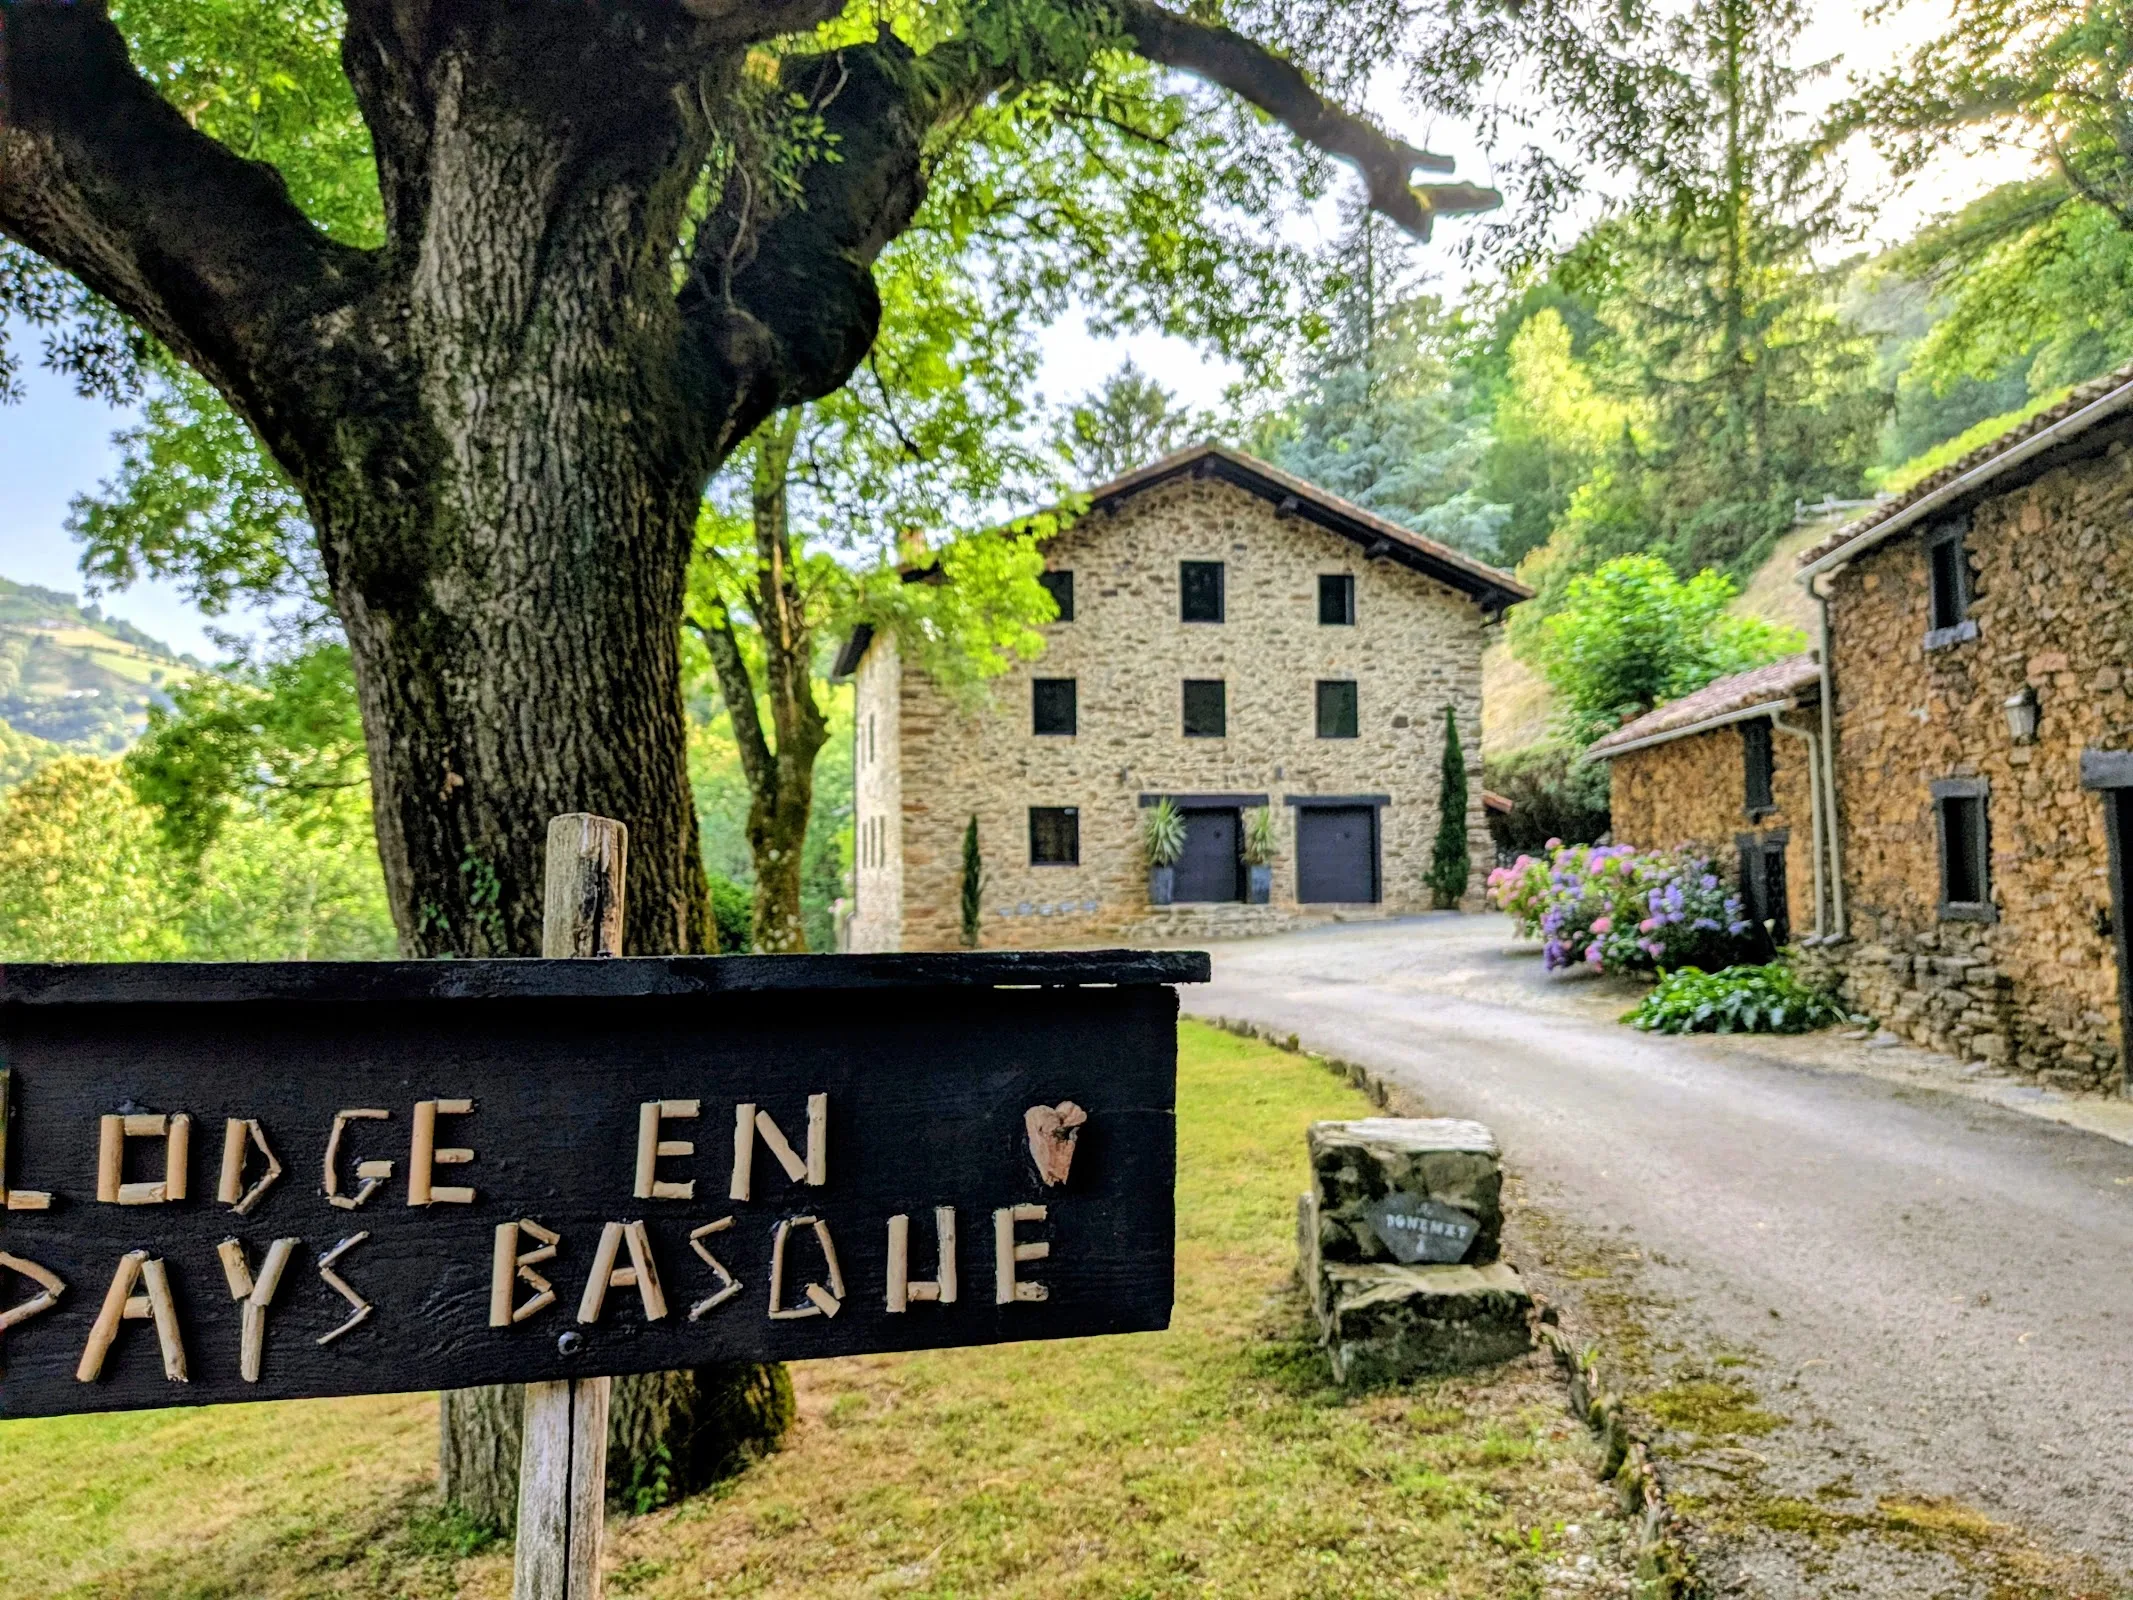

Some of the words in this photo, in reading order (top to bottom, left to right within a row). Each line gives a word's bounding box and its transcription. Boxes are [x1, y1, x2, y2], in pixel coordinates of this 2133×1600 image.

[0, 1069, 476, 1213] LODGE
[634, 1093, 828, 1201] EN
[489, 1203, 1050, 1326] BASQUE
